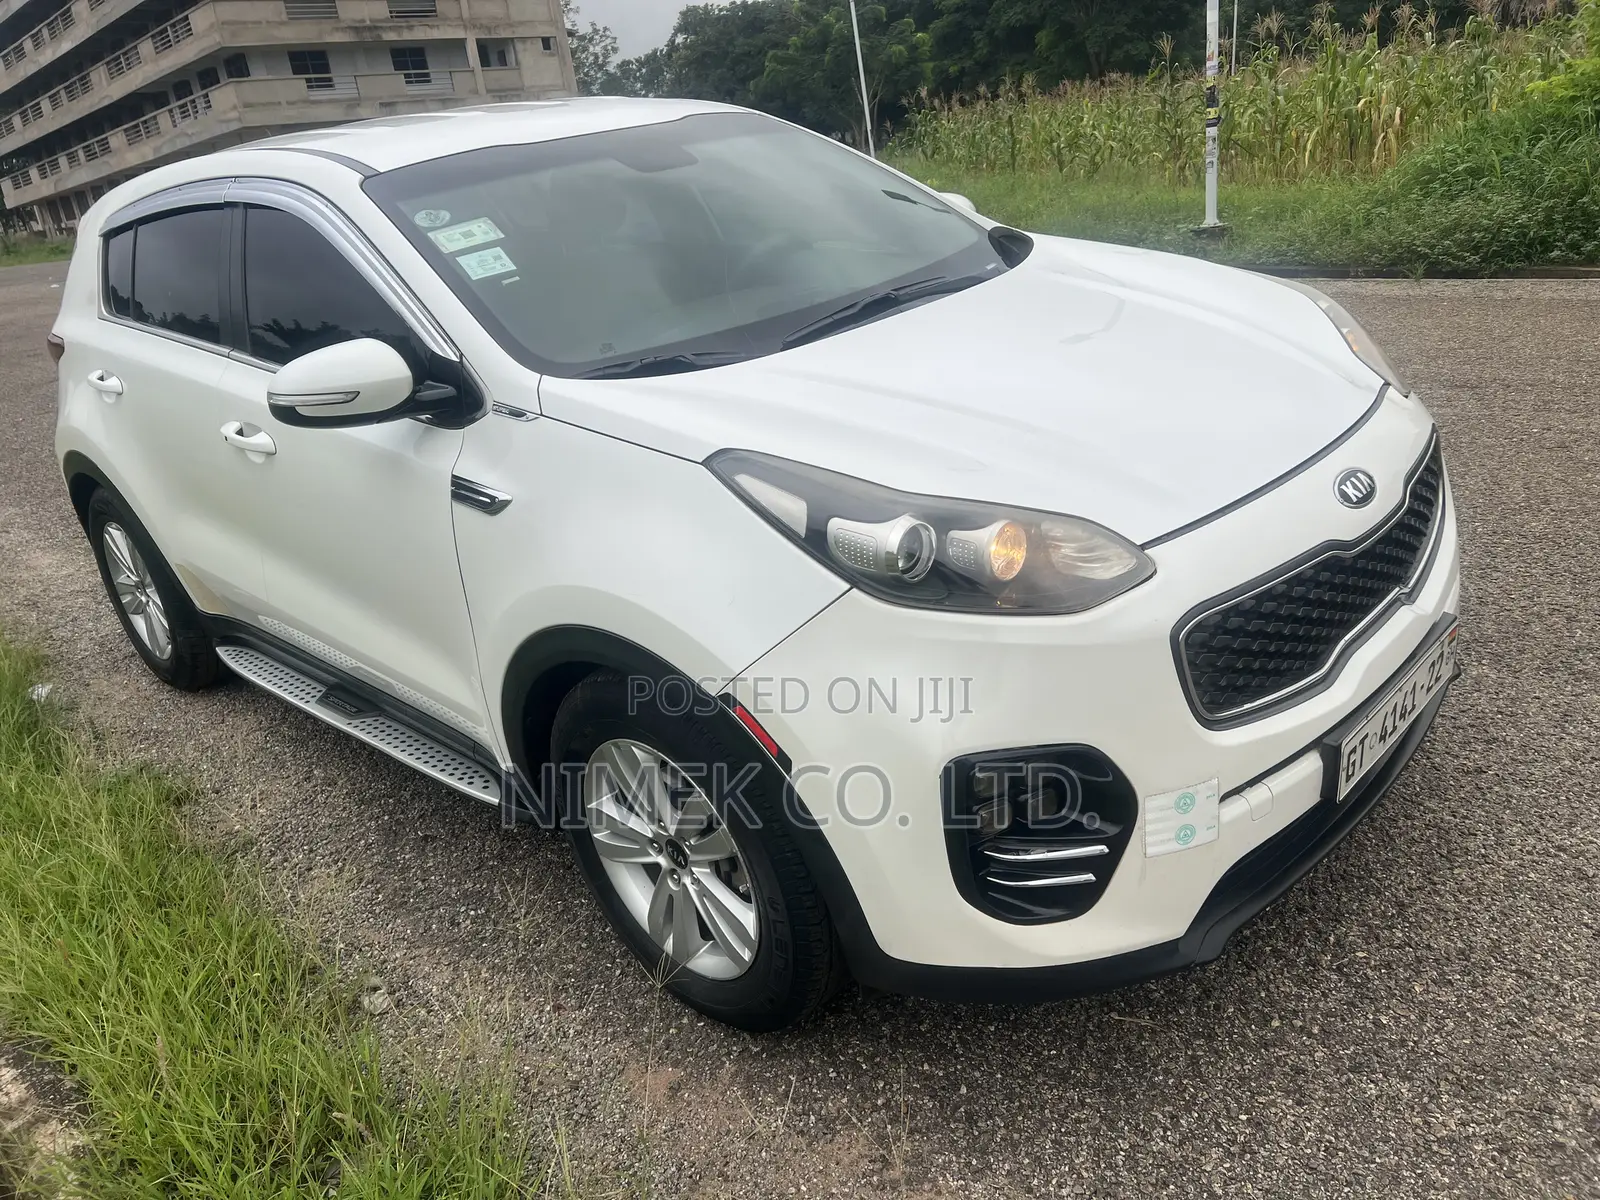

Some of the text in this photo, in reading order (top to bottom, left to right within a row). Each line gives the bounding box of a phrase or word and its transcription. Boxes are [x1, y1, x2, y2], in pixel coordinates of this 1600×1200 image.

[1340, 472, 1375, 502] KIA
[1345, 732, 1370, 783] GT
[667, 844, 685, 866] KIA
